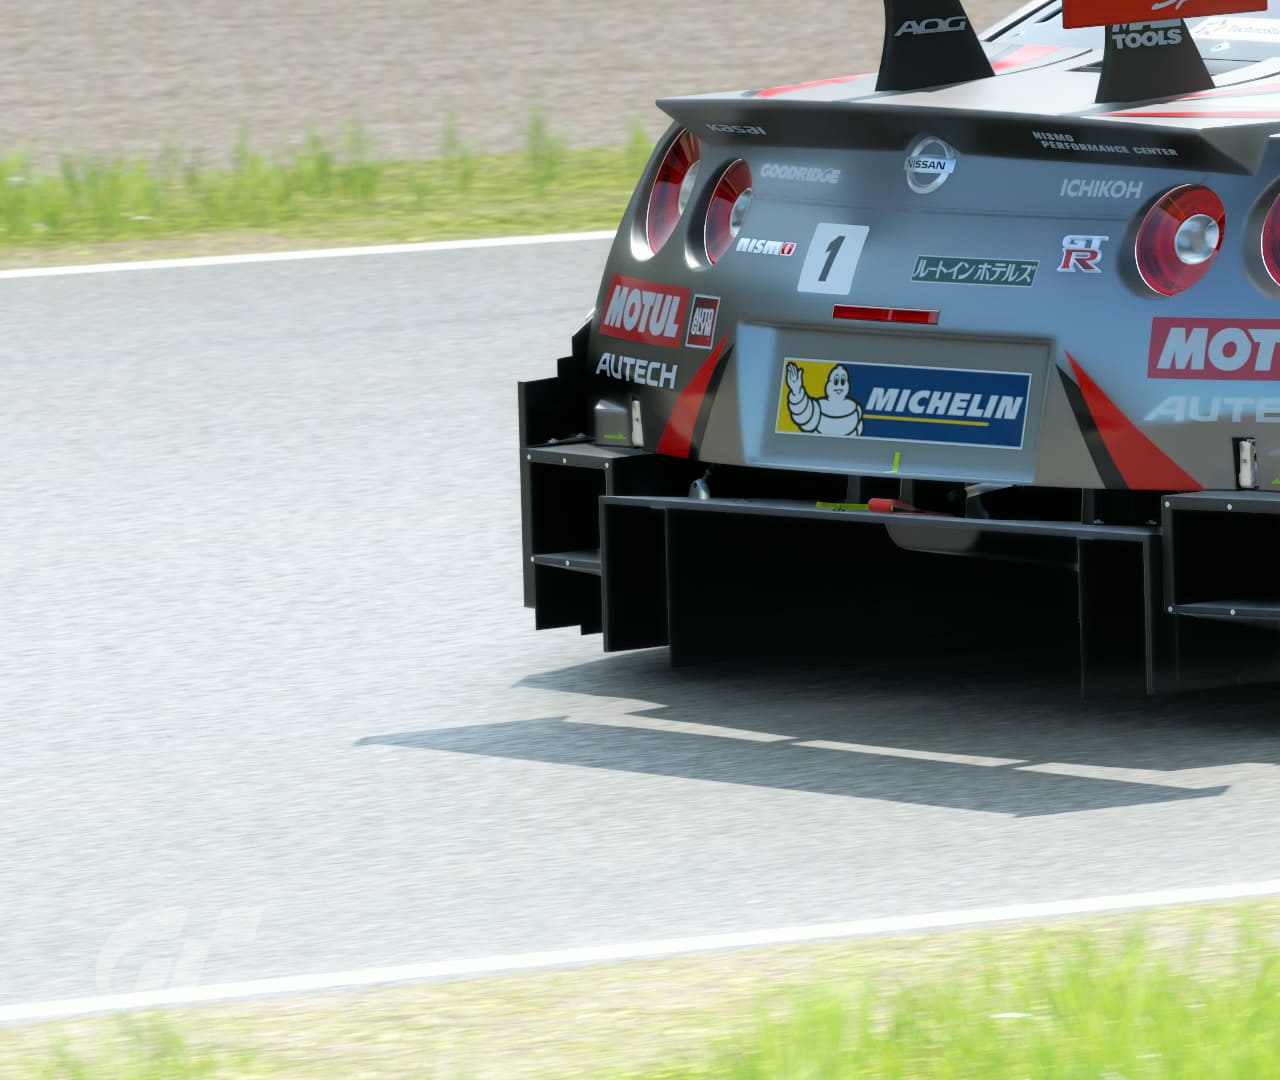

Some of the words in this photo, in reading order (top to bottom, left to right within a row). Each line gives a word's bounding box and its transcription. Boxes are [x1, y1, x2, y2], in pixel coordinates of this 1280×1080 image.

[1112, 29, 1183, 50] TOOLS
[1040, 140, 1131, 154] PERFORMANCE
[1132, 146, 1178, 156] CENTER
[760, 163, 842, 185] GOODRIDGE
[906, 158, 946, 171] NISSAN
[1060, 178, 1144, 199] ICHIKOH
[818, 235, 846, 283] 1
[913, 259, 1038, 284] ルートインホテルズ
[604, 285, 681, 338] MOTUL
[692, 306, 714, 322] AUTO
[690, 320, 712, 336] GLYM
[595, 352, 678, 390] AUTECH
[866, 387, 1023, 421] MICHELIN
